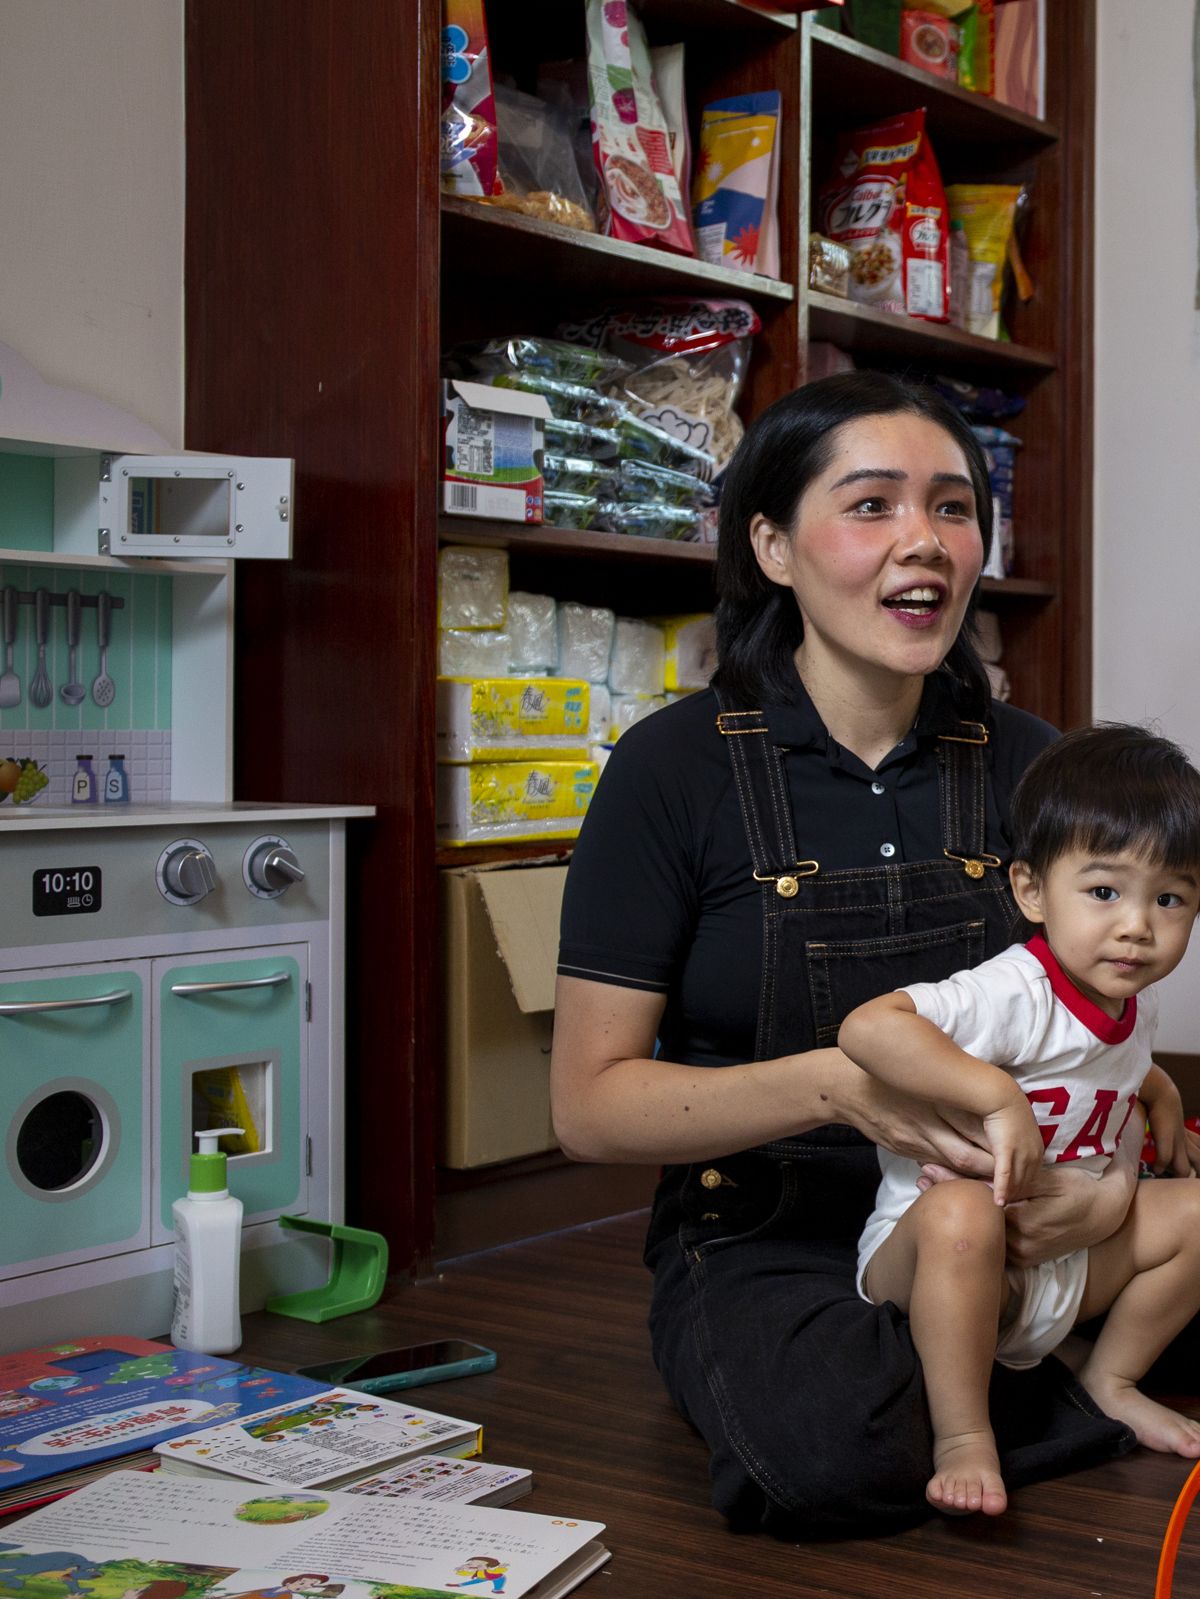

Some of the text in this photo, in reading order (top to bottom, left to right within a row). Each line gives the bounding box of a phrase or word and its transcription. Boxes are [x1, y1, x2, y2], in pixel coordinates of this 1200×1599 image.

[77, 779, 88, 794] P
[109, 779, 120, 793] S
[42, 872, 94, 893] 10:10
[1025, 1086, 1138, 1163] GA
